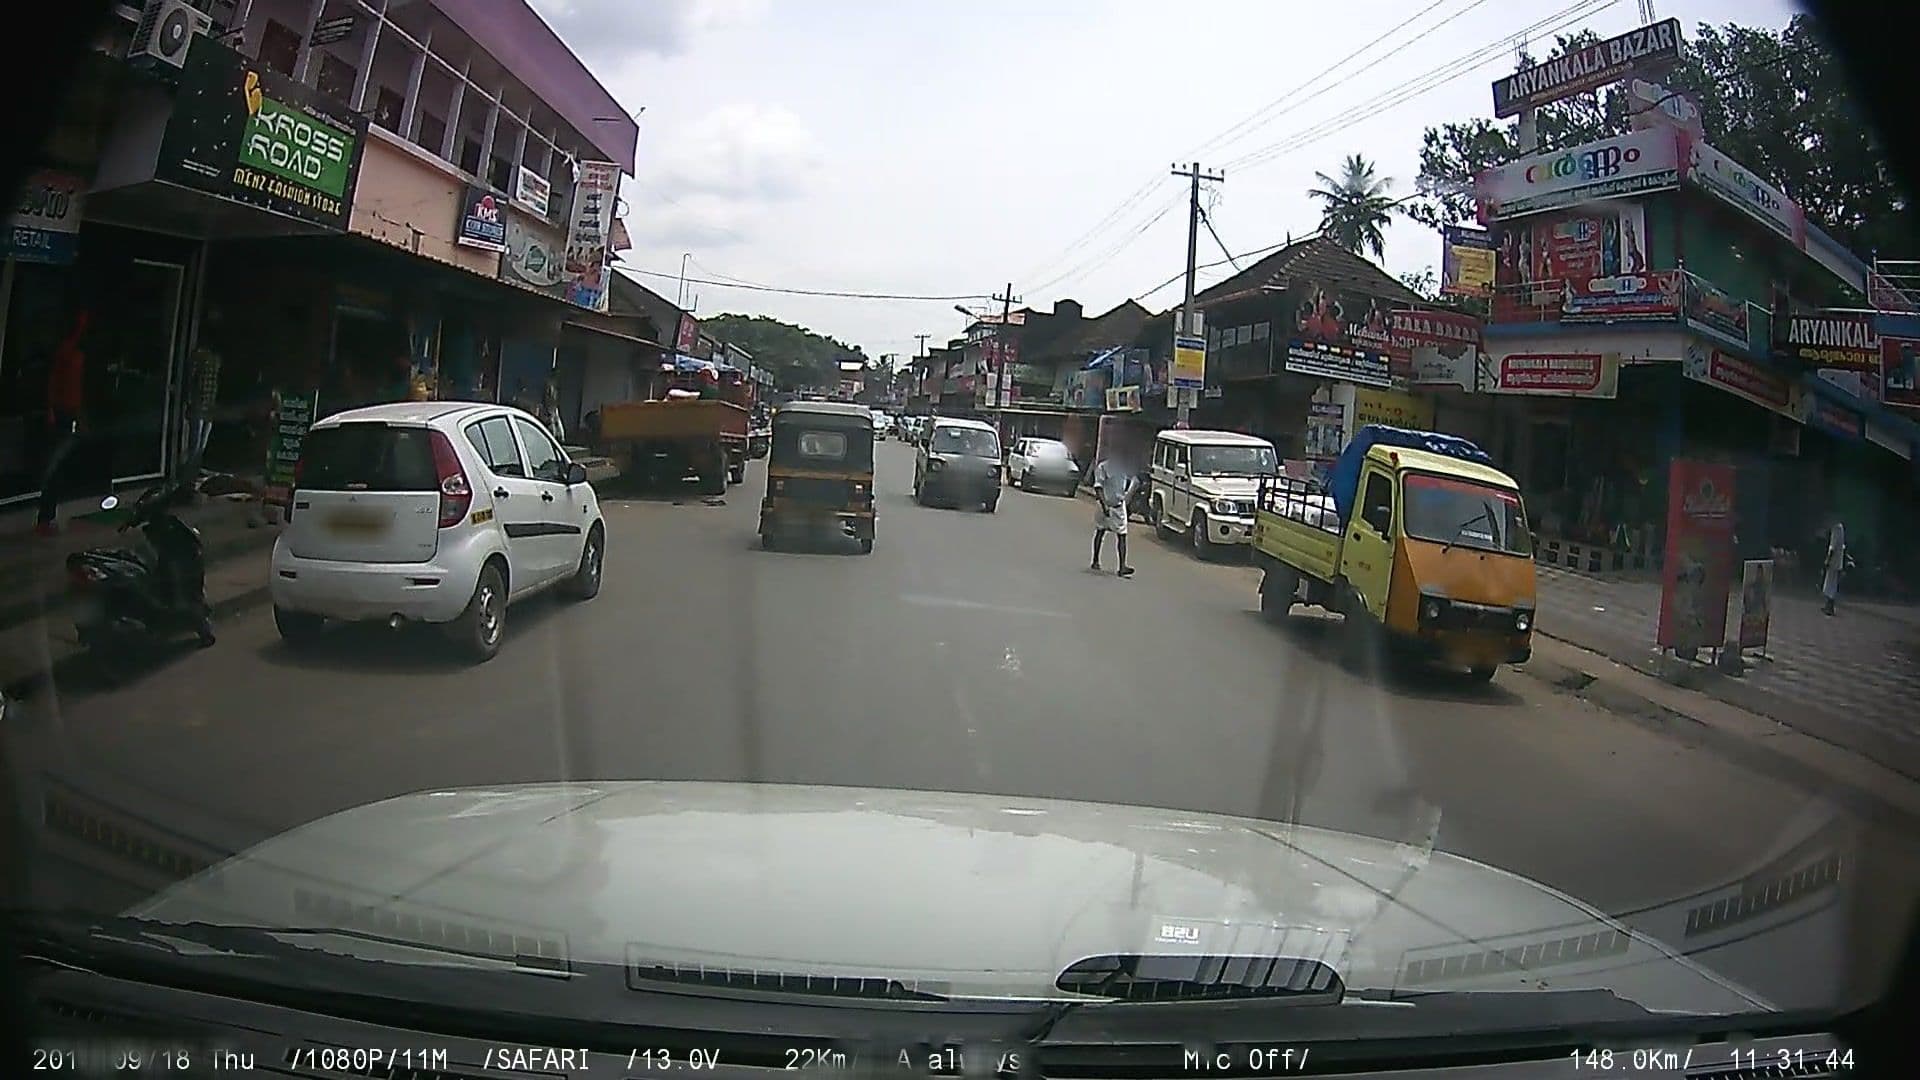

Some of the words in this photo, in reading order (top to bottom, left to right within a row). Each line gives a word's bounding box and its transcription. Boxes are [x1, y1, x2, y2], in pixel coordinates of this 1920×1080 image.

[1508, 47, 1607, 100] ARYANKALA
[1610, 23, 1673, 65] BAZAR
[247, 133, 321, 180] ROAD
[255, 106, 344, 162] KROSS
[233, 168, 267, 191] MENZ
[268, 180, 311, 205] FASHION
[312, 194, 341, 215] STORE
